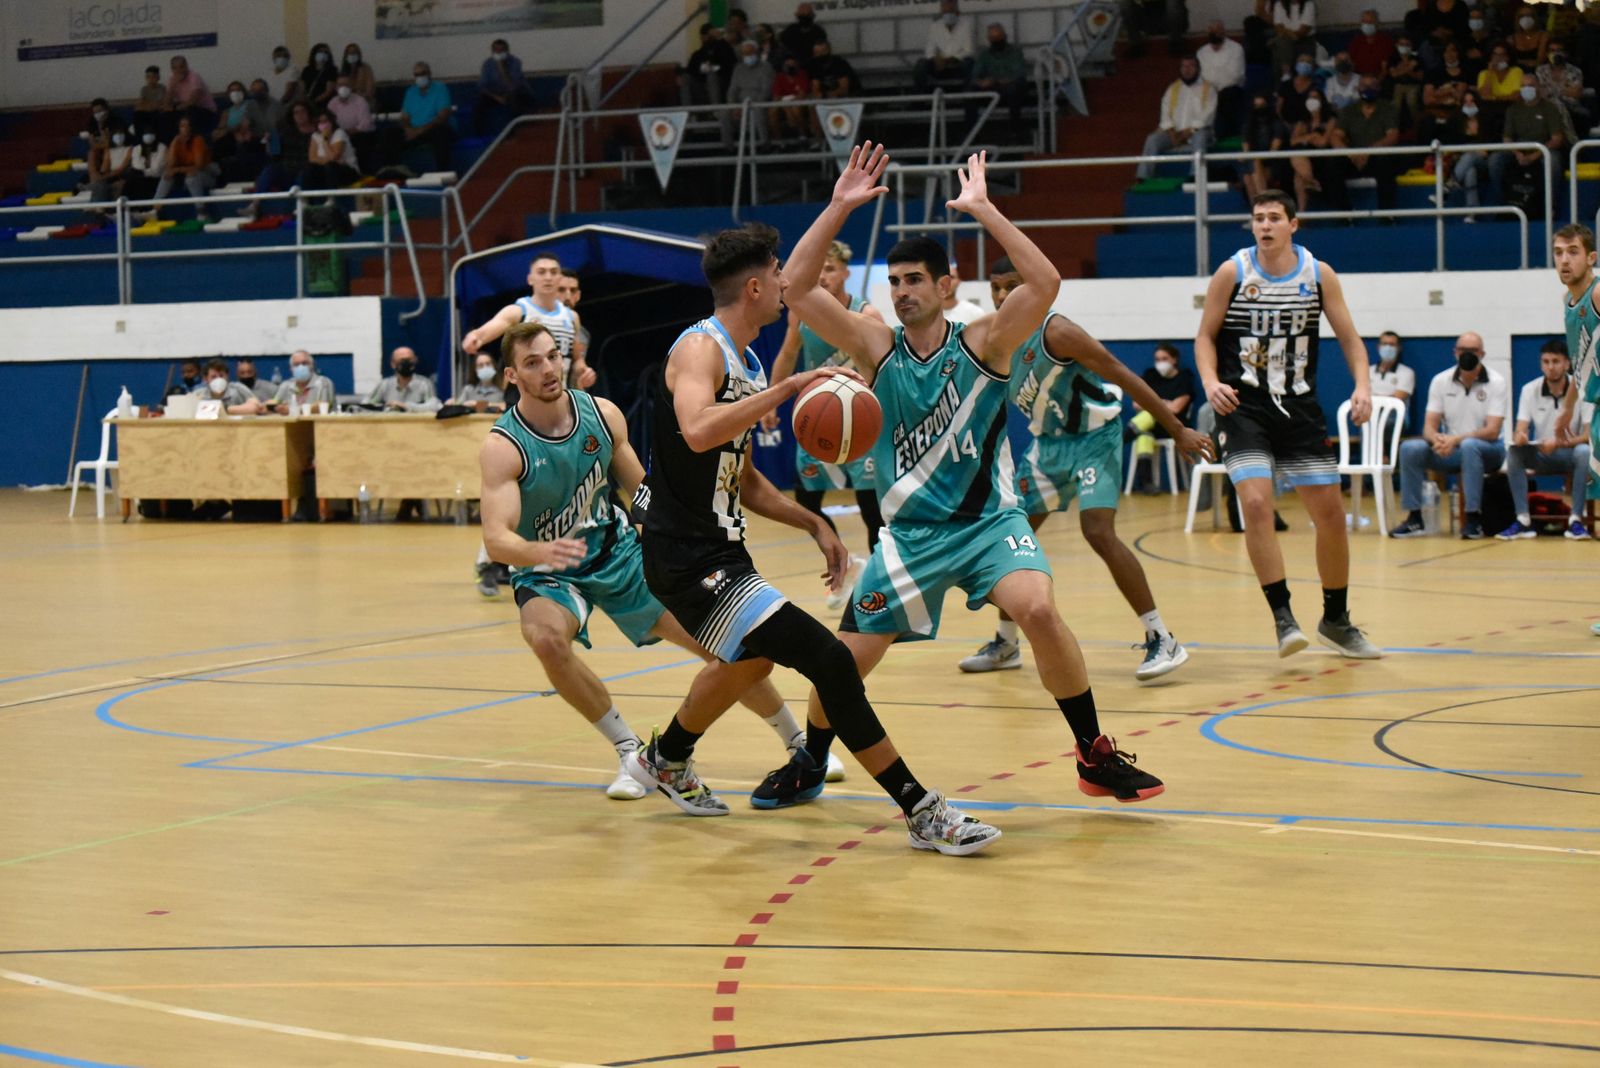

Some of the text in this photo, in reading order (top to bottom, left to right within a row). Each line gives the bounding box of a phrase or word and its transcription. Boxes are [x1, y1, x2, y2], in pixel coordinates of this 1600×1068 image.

[895, 377, 961, 481] ESTEPONA
[947, 429, 978, 463] 14
[536, 456, 604, 542] ESTEPONA
[534, 508, 552, 529] CAB
[1003, 534, 1037, 551] 14
